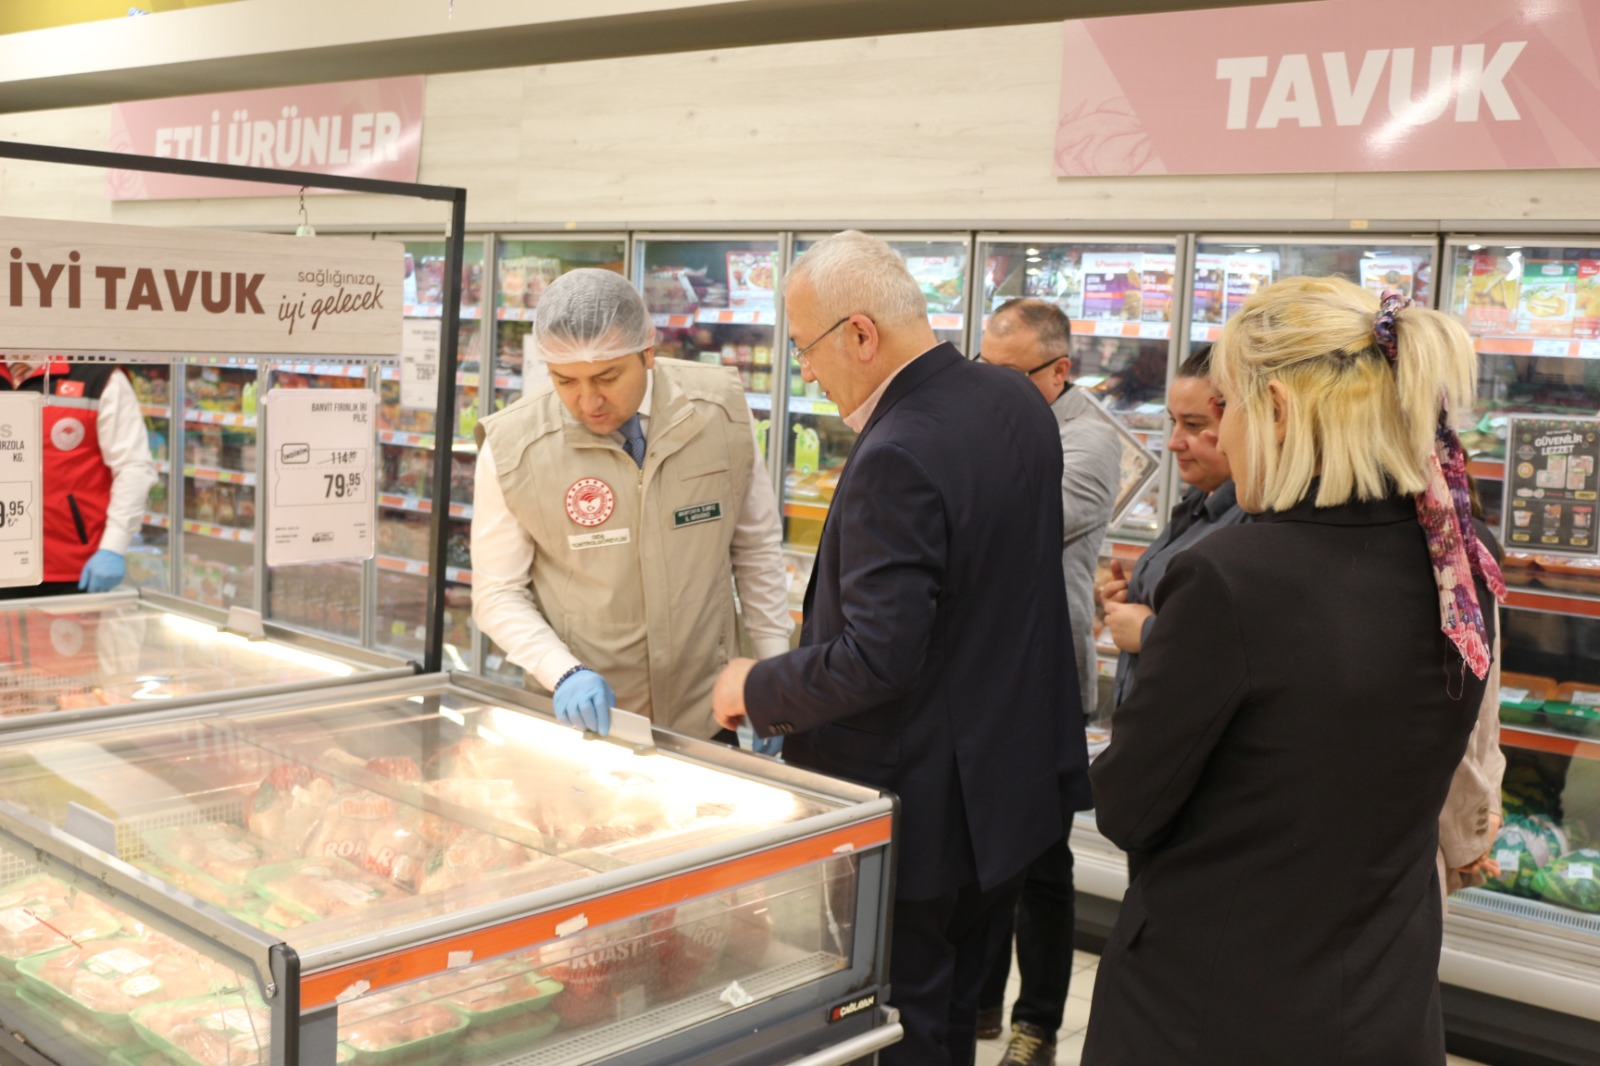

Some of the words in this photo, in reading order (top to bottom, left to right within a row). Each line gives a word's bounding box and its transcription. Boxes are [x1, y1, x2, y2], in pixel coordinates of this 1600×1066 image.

[1215, 40, 1528, 131] TAVUK
[227, 105, 402, 168] ÜRÜNLER
[9, 247, 81, 308] İYİ
[95, 265, 266, 315] TAVUK
[278, 294, 307, 335] iyi
[311, 282, 384, 331] gelecek
[297, 268, 375, 288] sağlığınıza
